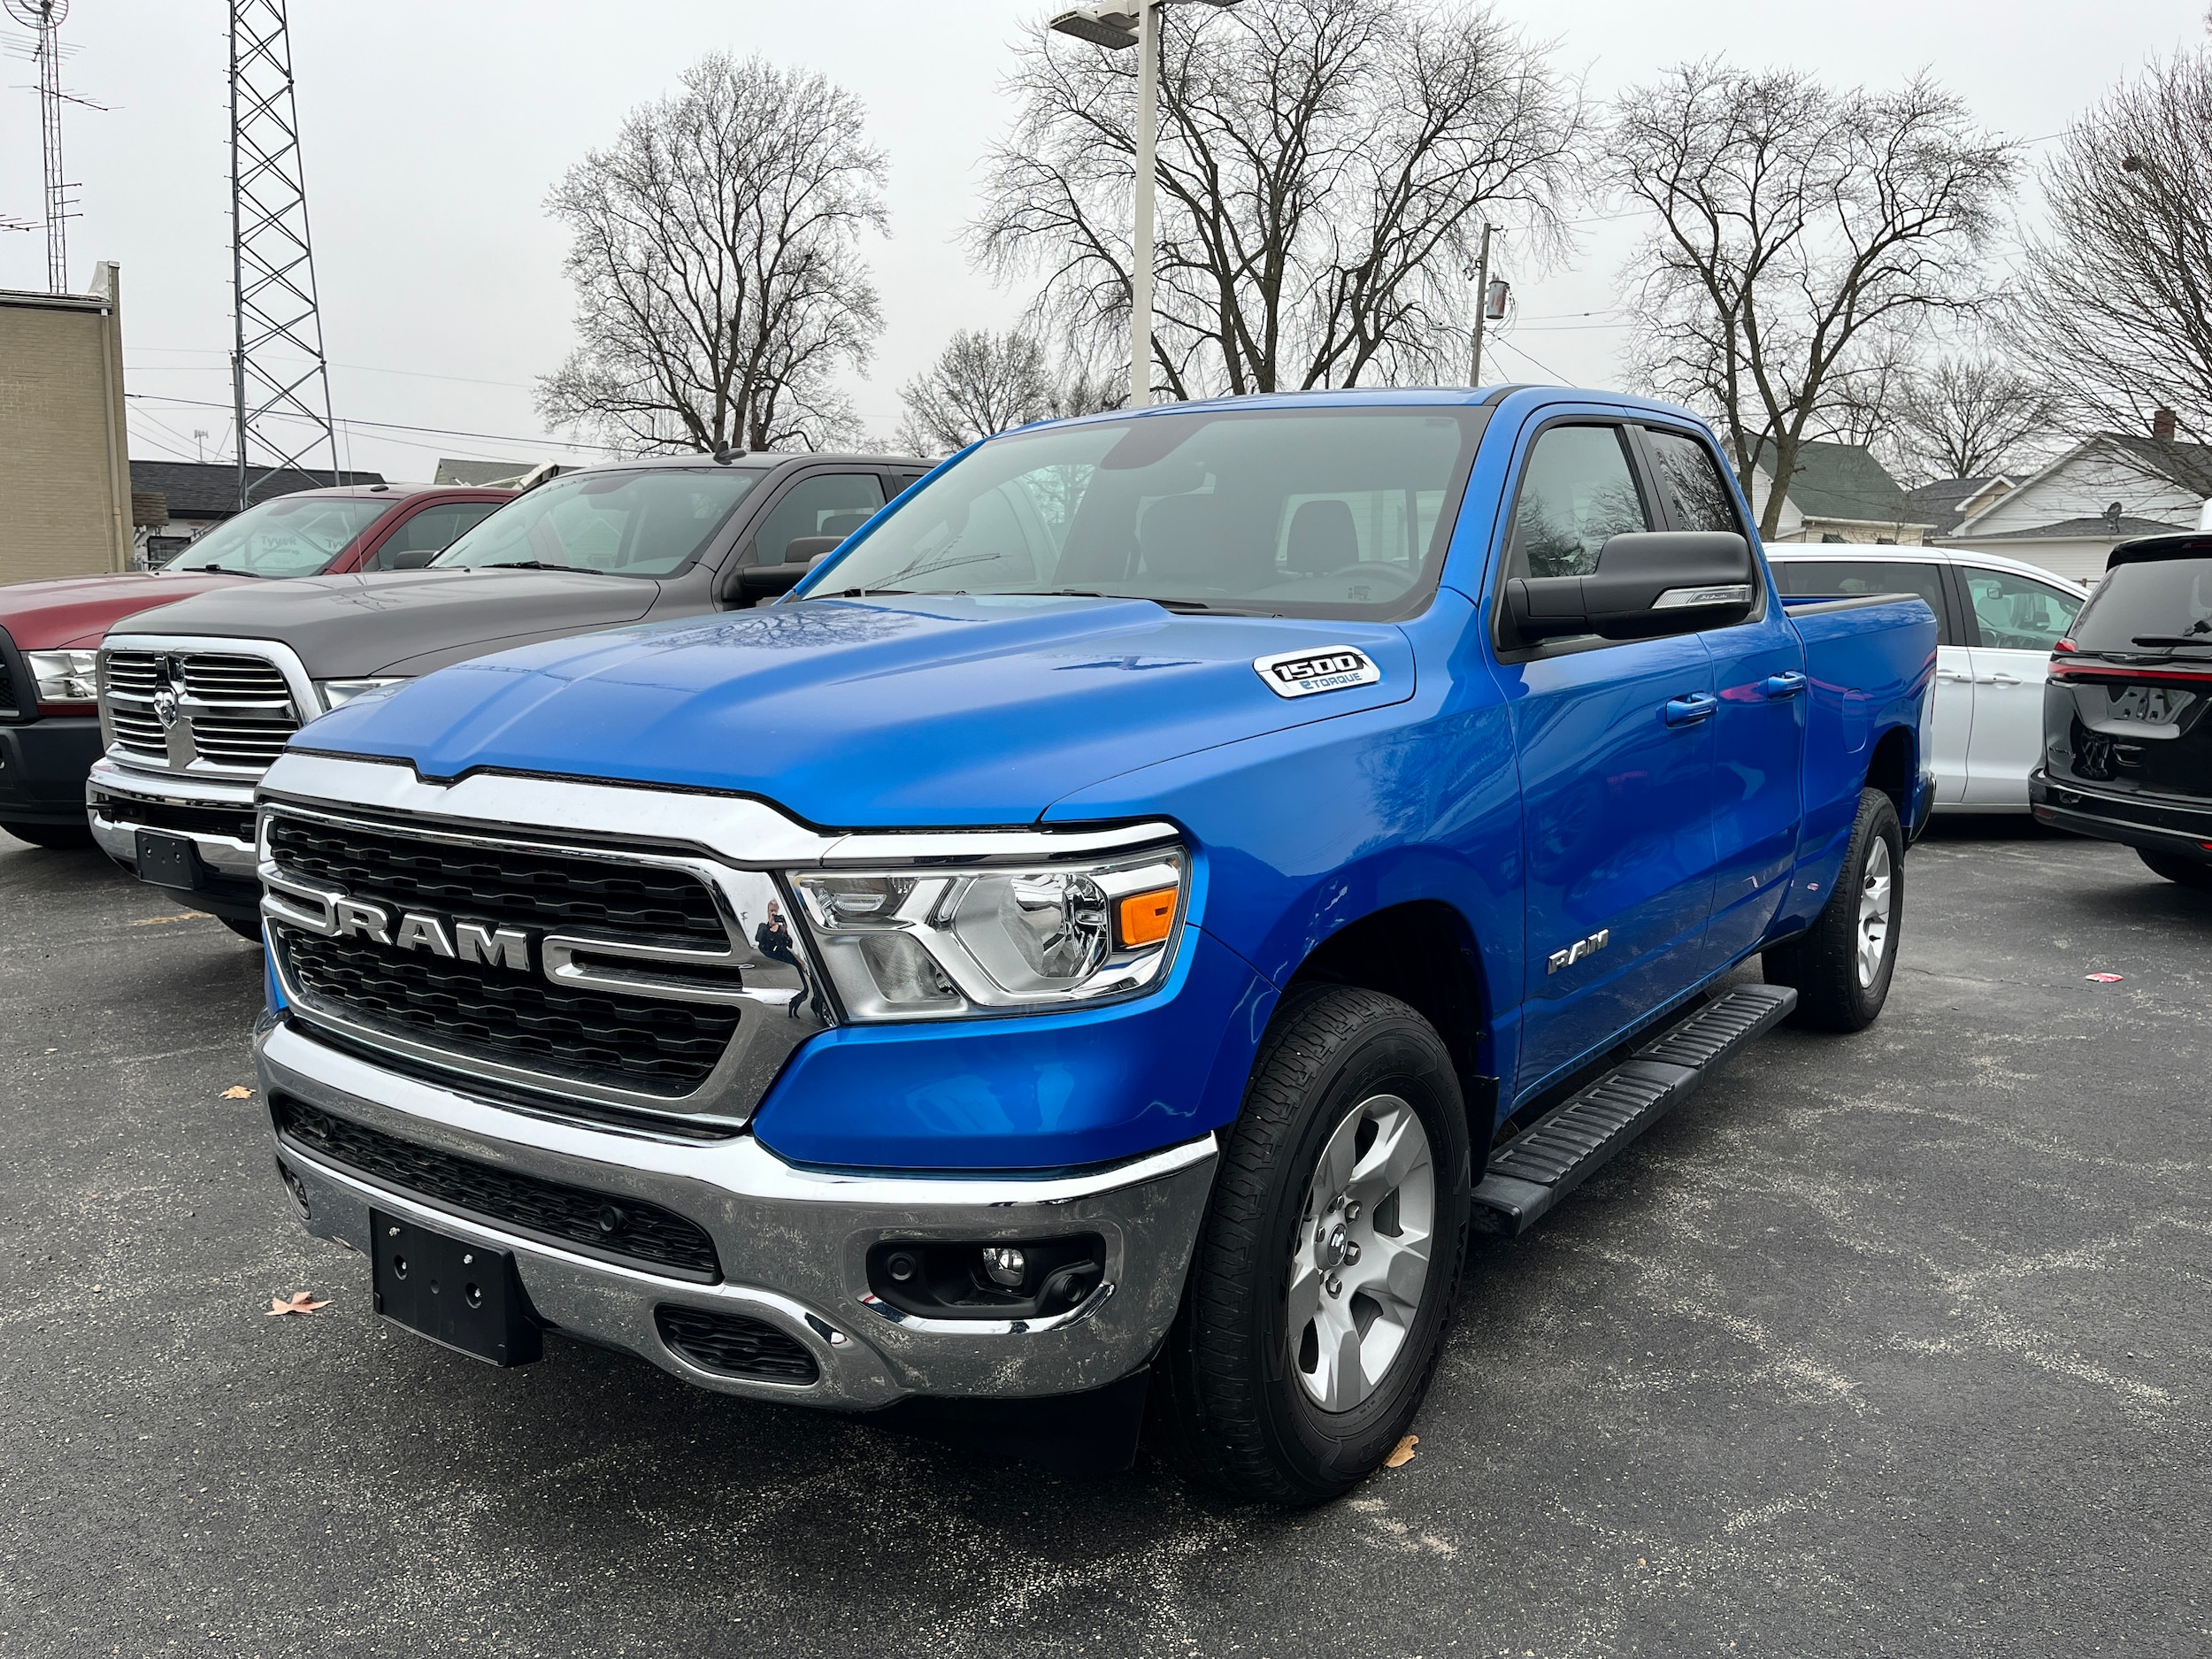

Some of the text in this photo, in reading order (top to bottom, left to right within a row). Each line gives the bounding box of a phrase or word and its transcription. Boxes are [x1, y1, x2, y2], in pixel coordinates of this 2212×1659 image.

[1275, 655, 1358, 680] 1500
[1299, 672, 1363, 690] eTORQUE
[337, 898, 531, 972] RAM
[1548, 929, 1609, 975] RAM
